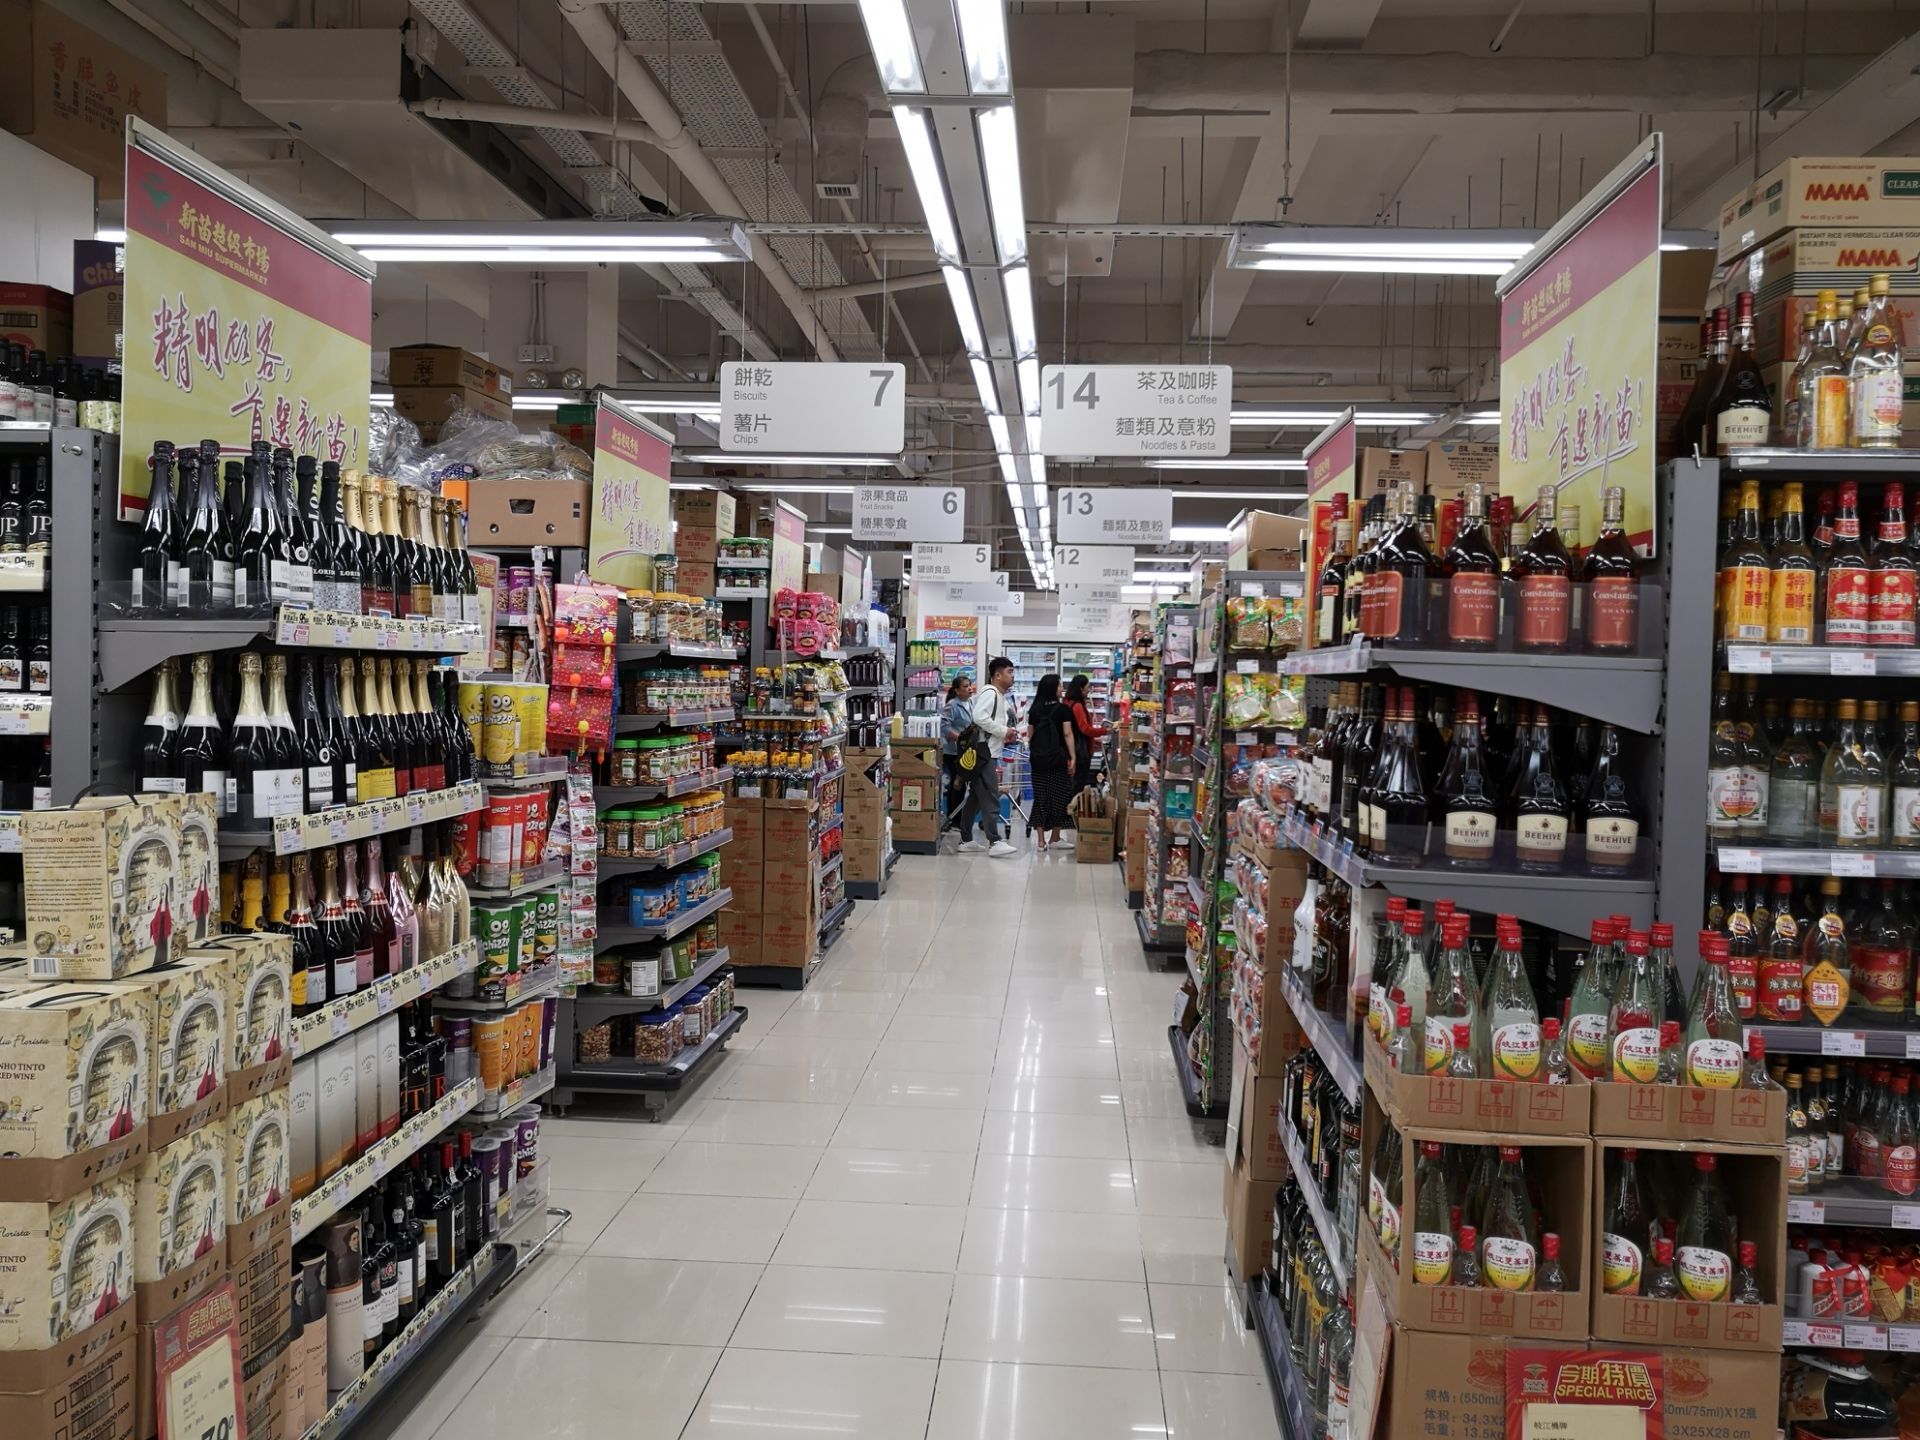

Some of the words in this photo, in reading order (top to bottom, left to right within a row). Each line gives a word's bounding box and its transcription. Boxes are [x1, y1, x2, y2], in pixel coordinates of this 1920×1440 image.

[1806, 183, 1870, 200] MAMA
[180, 234, 197, 249] SAN
[198, 243, 213, 258] MIU
[214, 252, 268, 286] SUPERMARKET
[1837, 249, 1902, 267] MAMA
[734, 368, 773, 387] 餅乾
[869, 370, 894, 407] 7
[1047, 371, 1100, 410] 14
[1137, 371, 1218, 391] 茶及咖啡
[733, 390, 767, 401] Biscuits
[1158, 395, 1175, 405] Tea
[1177, 395, 1184, 405] &
[1186, 395, 1217, 405] Coffee
[733, 413, 773, 433] 薯片
[1115, 417, 1216, 436] 麵類及意粉
[1725, 425, 1764, 434] BEEHIVE
[733, 434, 758, 446] Chips
[1141, 440, 1178, 450] Noodles
[1181, 440, 1187, 450] &
[1190, 440, 1216, 450] Pasta
[861, 490, 908, 502] 涼果食品
[942, 491, 958, 515] 6
[1062, 492, 1093, 515] 13
[29, 515, 52, 535] JP
[860, 517, 907, 529] 糖果零食
[975, 547, 986, 563] 5
[1057, 549, 1080, 565] 12
[996, 574, 1005, 587] 4
[1014, 594, 1021, 604] 3
[1520, 589, 1567, 598] Constantino
[1453, 827, 1489, 838] BEEHIVE
[1524, 830, 1562, 841] BEEHIVE
[1594, 834, 1632, 844] BEEHIVE
[18, 1063, 46, 1071] TINTO
[13, 1072, 36, 1080] WINE
[1561, 1362, 1651, 1388] 今期特價
[1556, 1384, 1613, 1399] SPECIAL
[1616, 1387, 1654, 1401] PRICE
[1733, 1429, 1751, 1439] cm
